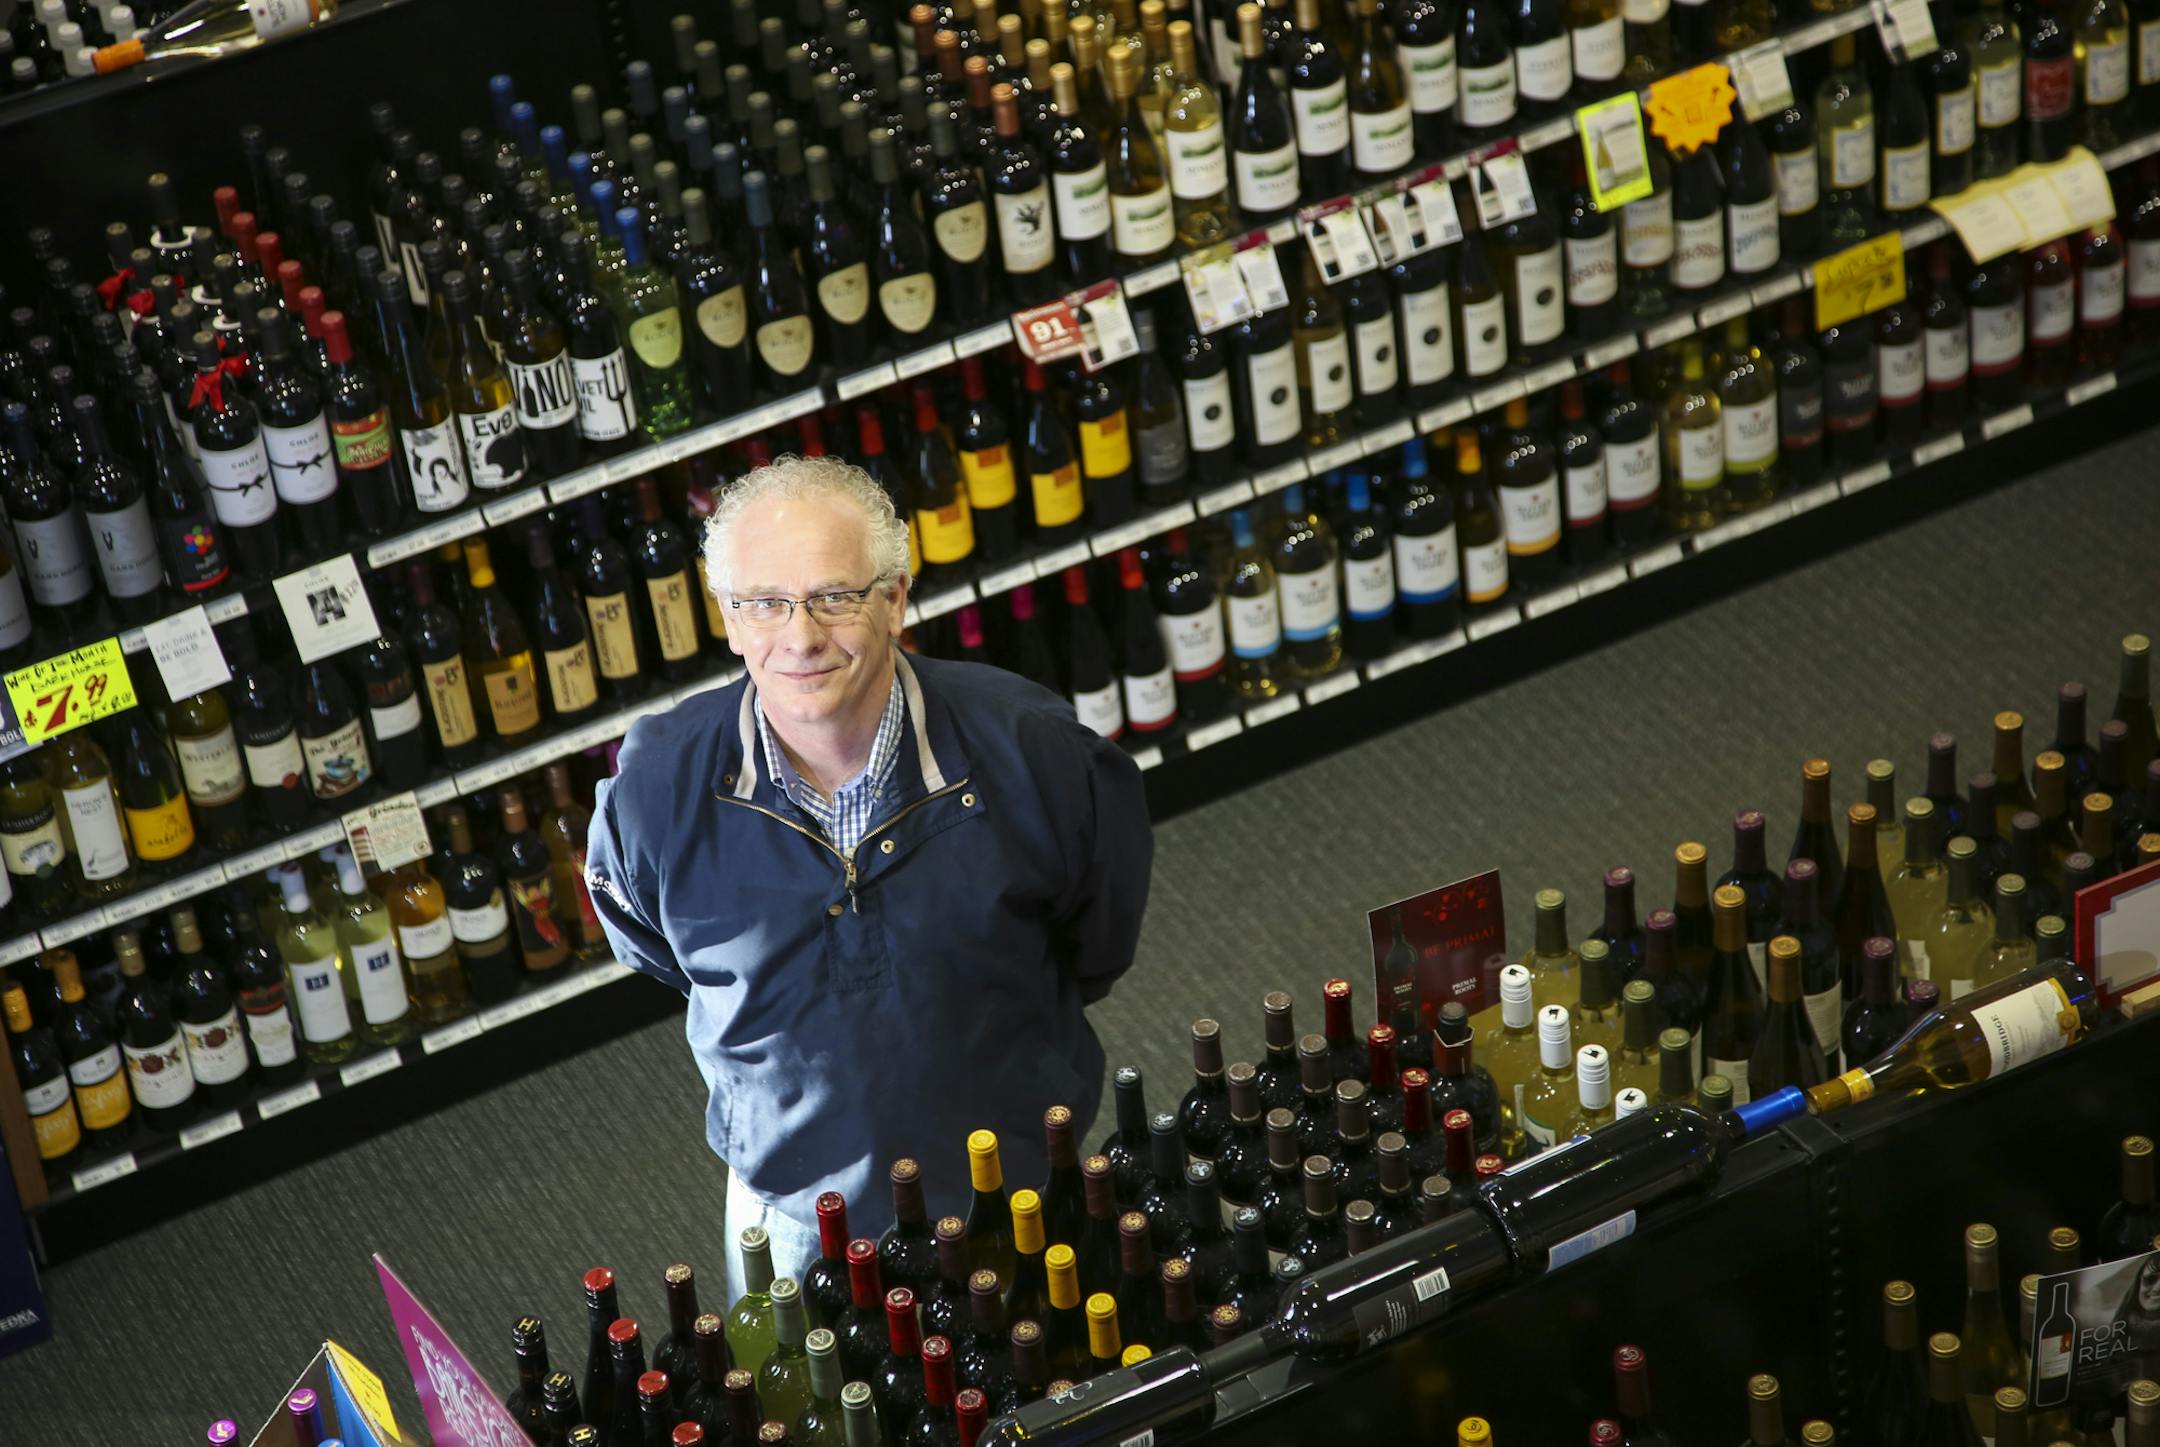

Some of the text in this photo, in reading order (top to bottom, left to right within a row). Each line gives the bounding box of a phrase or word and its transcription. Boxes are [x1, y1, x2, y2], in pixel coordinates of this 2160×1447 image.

[1029, 316, 1069, 343] 91
[1423, 926, 1496, 957] BE PRIMAL
[2080, 1319, 2127, 1346] FOR
[2079, 1335, 2139, 1364] REAL
